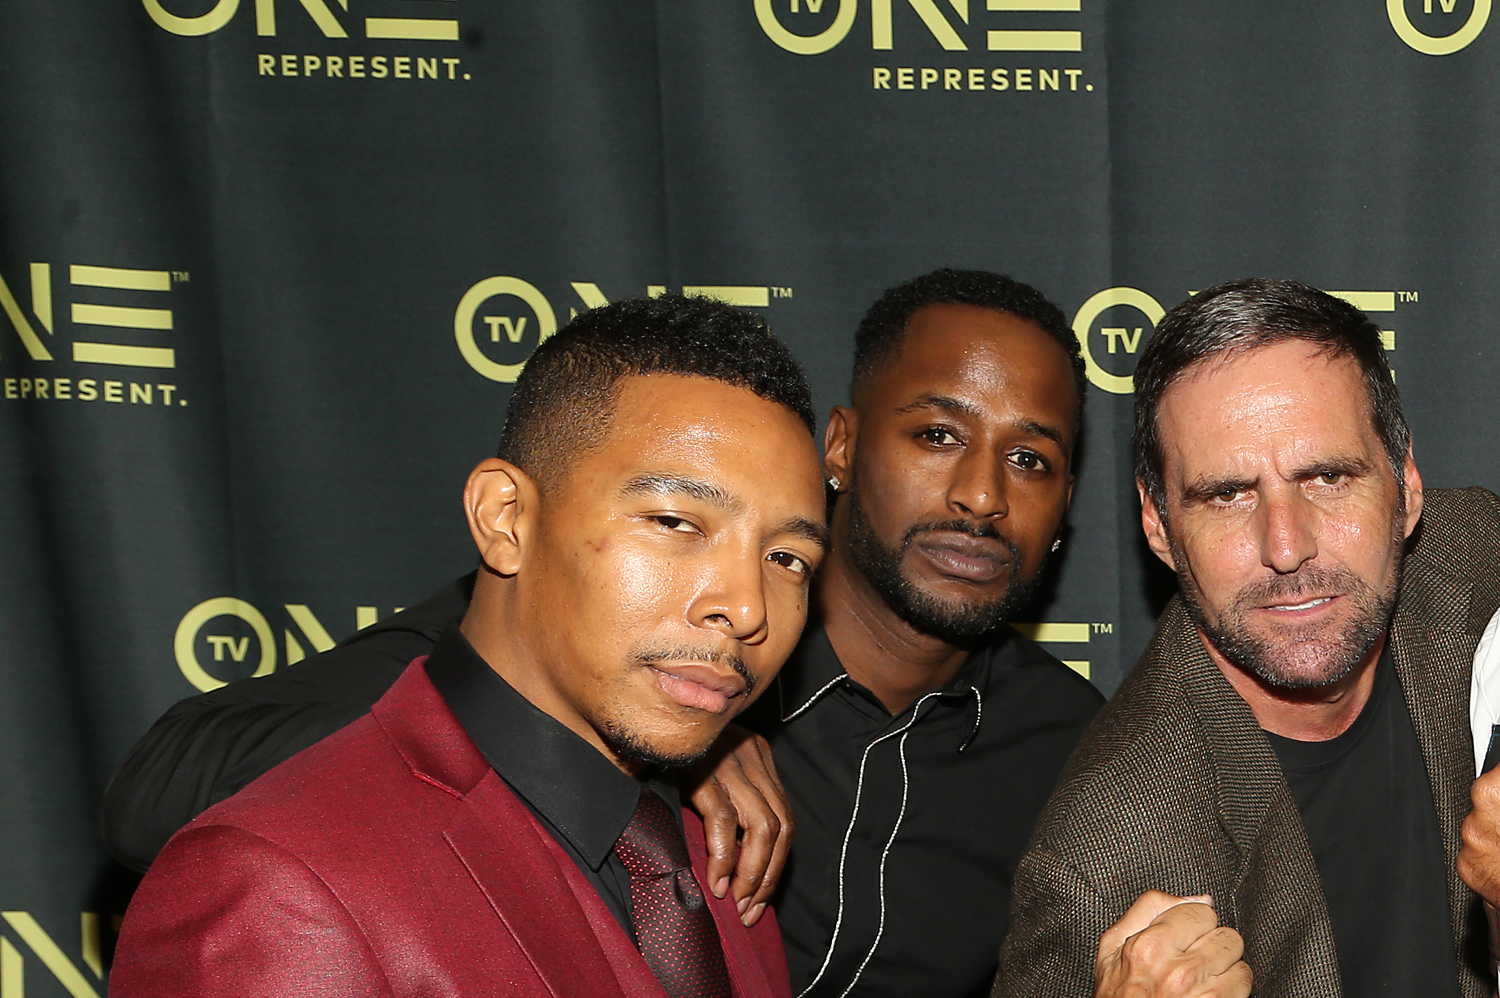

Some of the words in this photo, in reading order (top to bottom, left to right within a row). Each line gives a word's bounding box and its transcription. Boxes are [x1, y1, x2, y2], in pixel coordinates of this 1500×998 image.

[258, 54, 470, 80] REPRESENT.
[873, 67, 1094, 91] REPRESENT.
[0, 262, 175, 368] NE
[483, 316, 528, 343] TV
[1101, 328, 1143, 354] TV
[3, 377, 188, 407] EPRESENT.
[206, 635, 250, 662] TV
